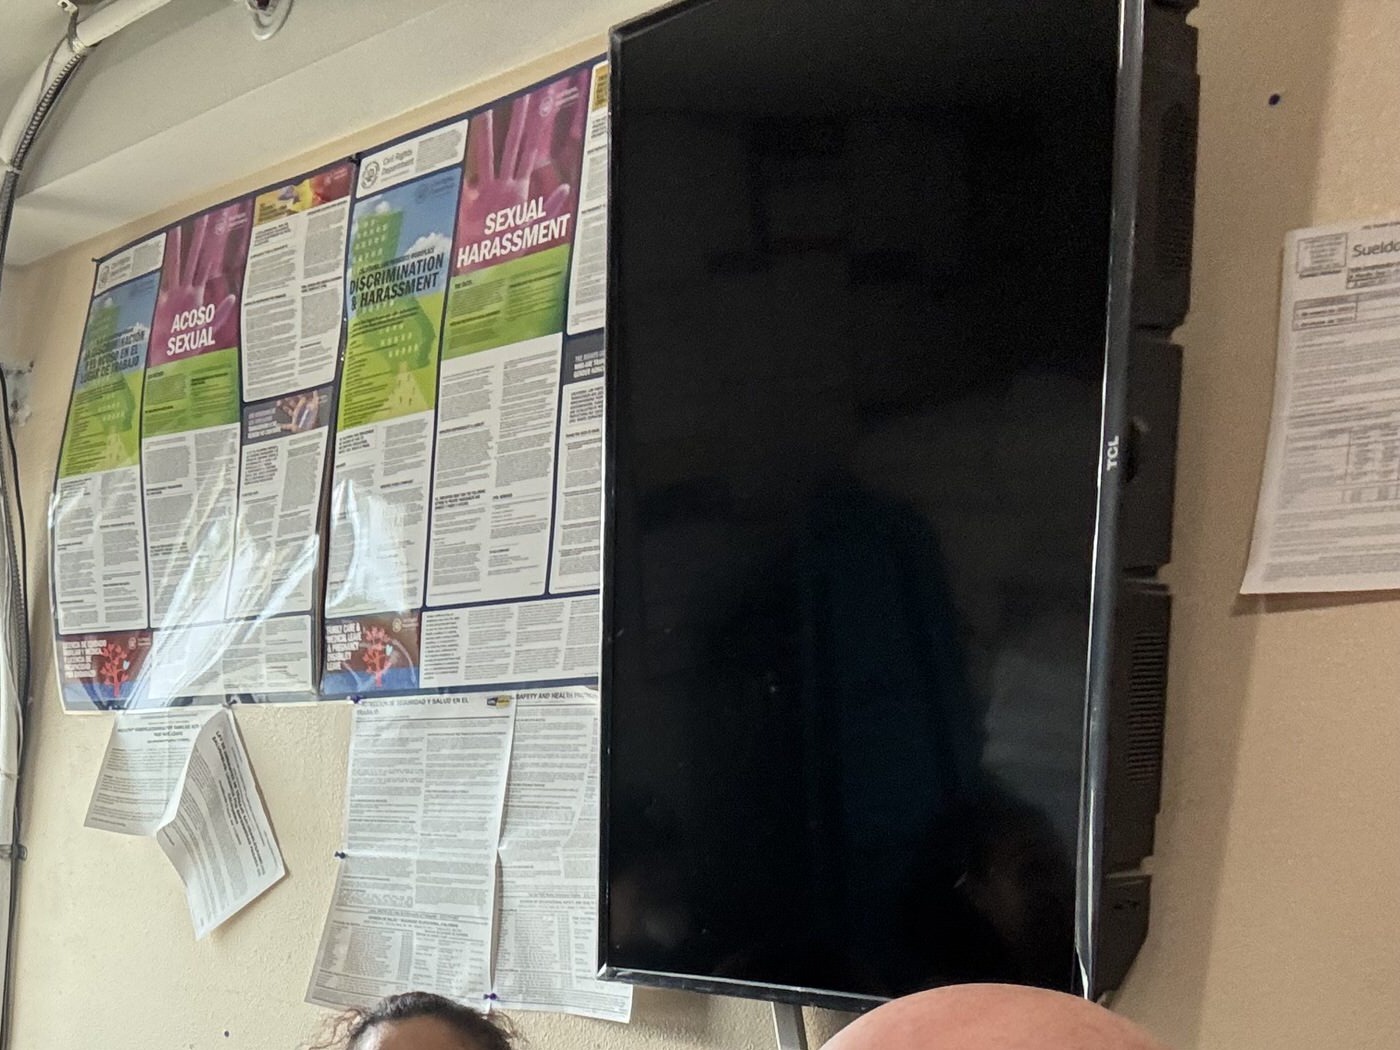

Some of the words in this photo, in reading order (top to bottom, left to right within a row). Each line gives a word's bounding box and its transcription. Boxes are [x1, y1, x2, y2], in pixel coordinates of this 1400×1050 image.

[484, 196, 547, 235] SEXUAL
[456, 213, 571, 268] HARASSMENT
[349, 252, 445, 295] DISCRIMINATION
[360, 272, 440, 307] HARASSMENT
[171, 303, 216, 334] ACOSO
[166, 326, 216, 356] SEXUAL
[1106, 435, 1119, 471] TCL
